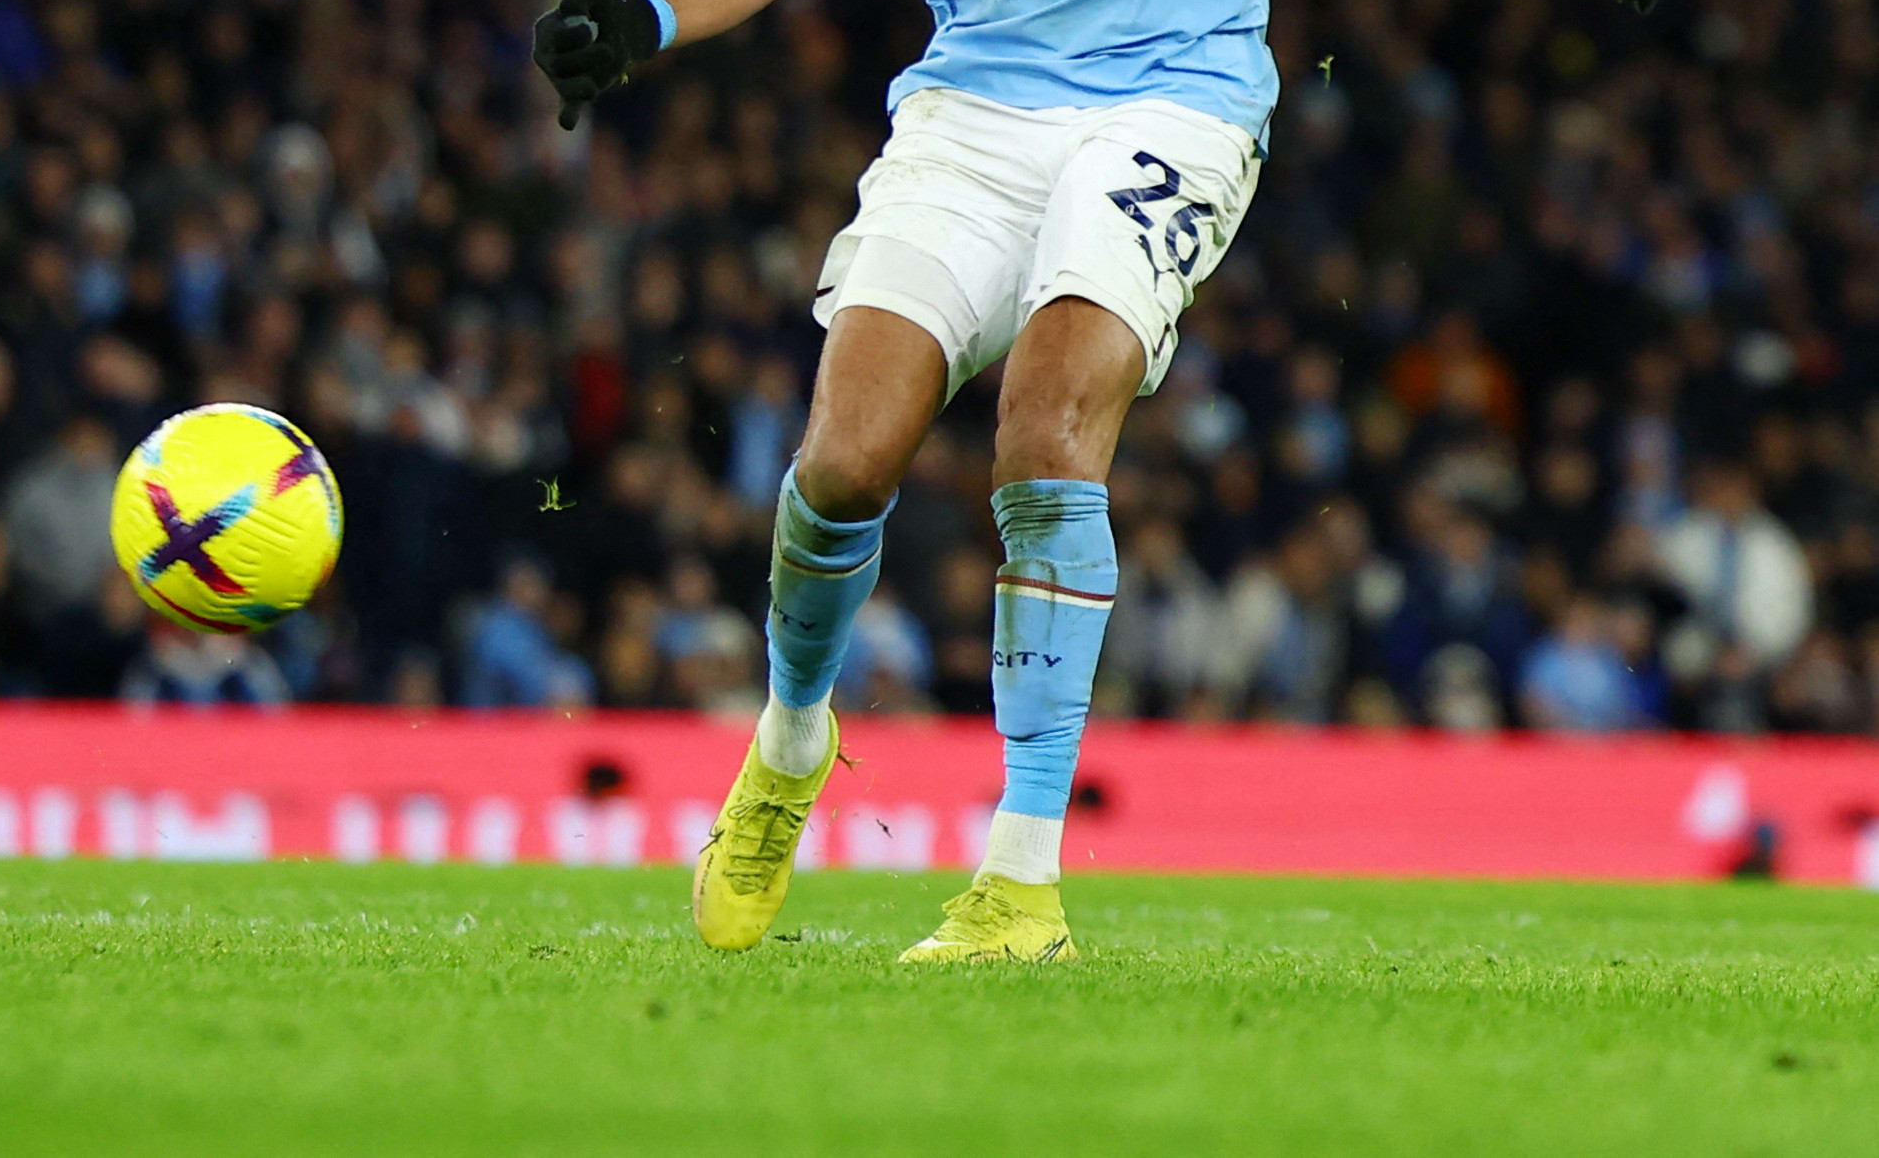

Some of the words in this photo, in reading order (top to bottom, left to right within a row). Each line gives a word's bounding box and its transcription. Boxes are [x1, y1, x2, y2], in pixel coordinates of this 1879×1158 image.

[1106, 150, 1214, 277] 26
[773, 603, 819, 631] ITY
[994, 650, 1062, 668] CITY
